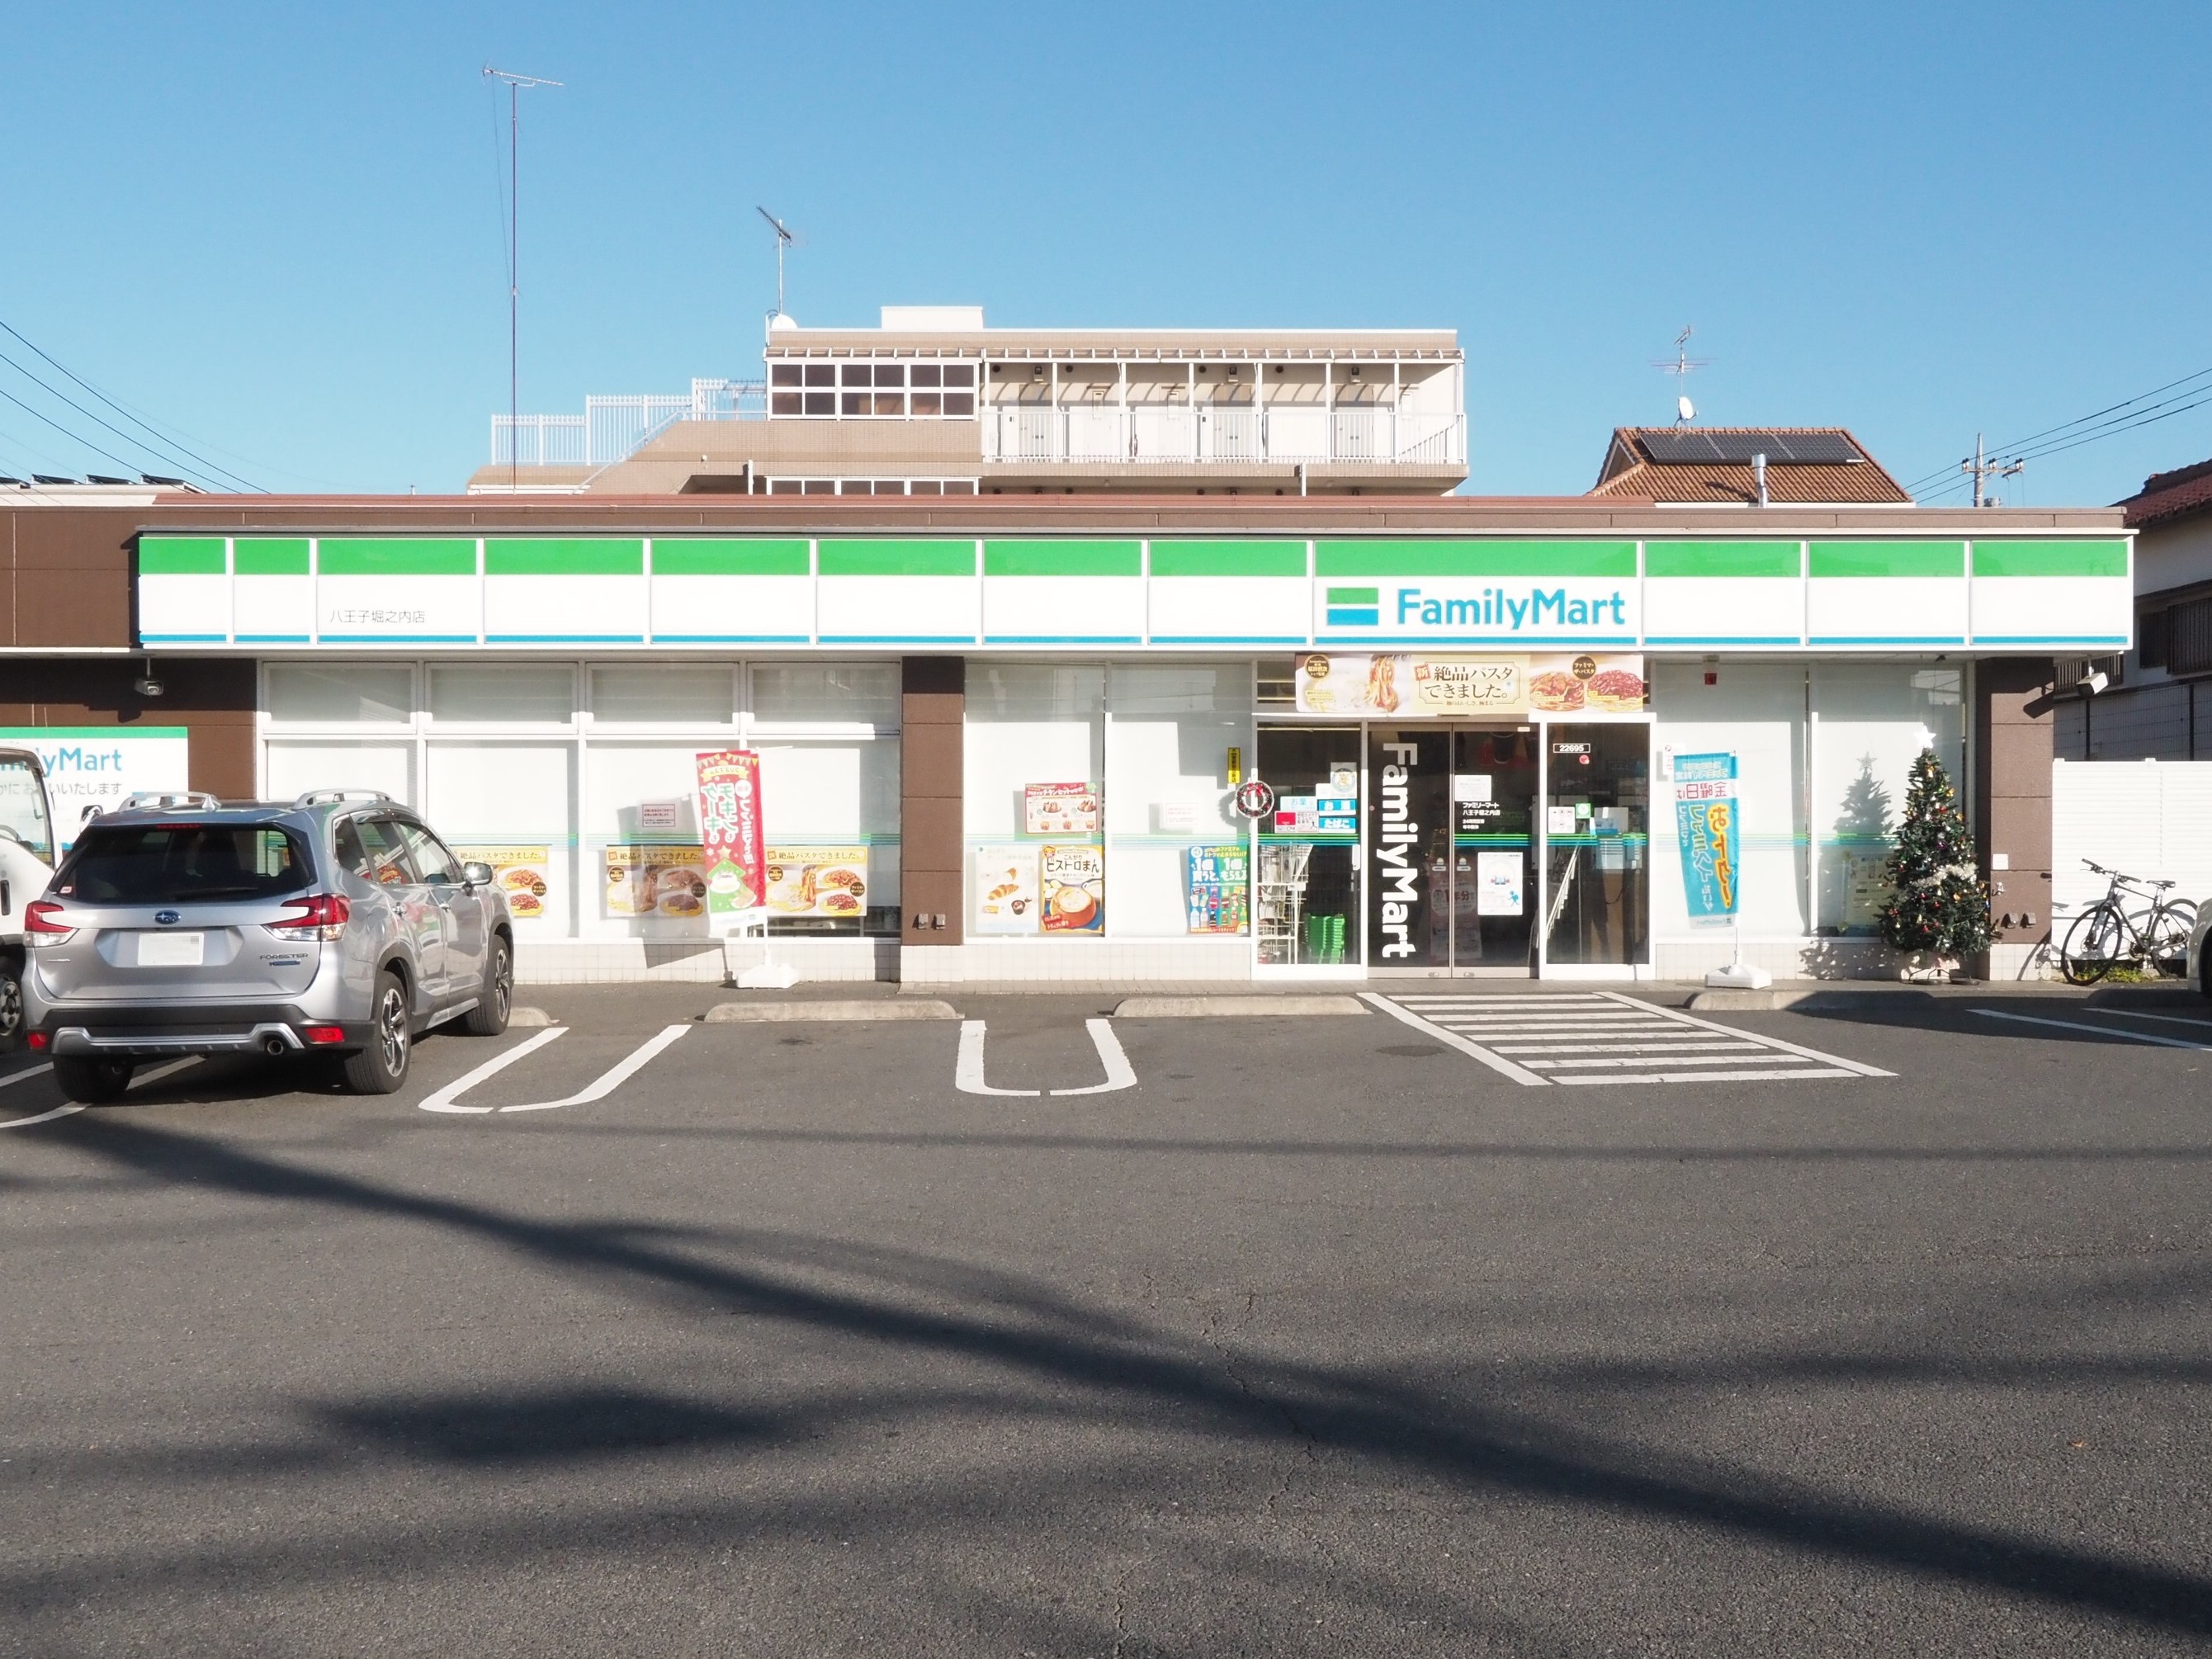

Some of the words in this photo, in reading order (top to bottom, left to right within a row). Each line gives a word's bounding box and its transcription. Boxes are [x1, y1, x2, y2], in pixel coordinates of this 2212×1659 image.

[330, 610, 426, 623] 八王子堀之内店
[1397, 588, 1626, 630] FamilyMart
[1434, 666, 1514, 681] 絶品パスタ
[1425, 684, 1508, 699] できました。
[1324, 818, 1350, 829] たばこ
[1376, 743, 1418, 957] FamilyMart
[1047, 858, 1100, 873] ビストロまん
